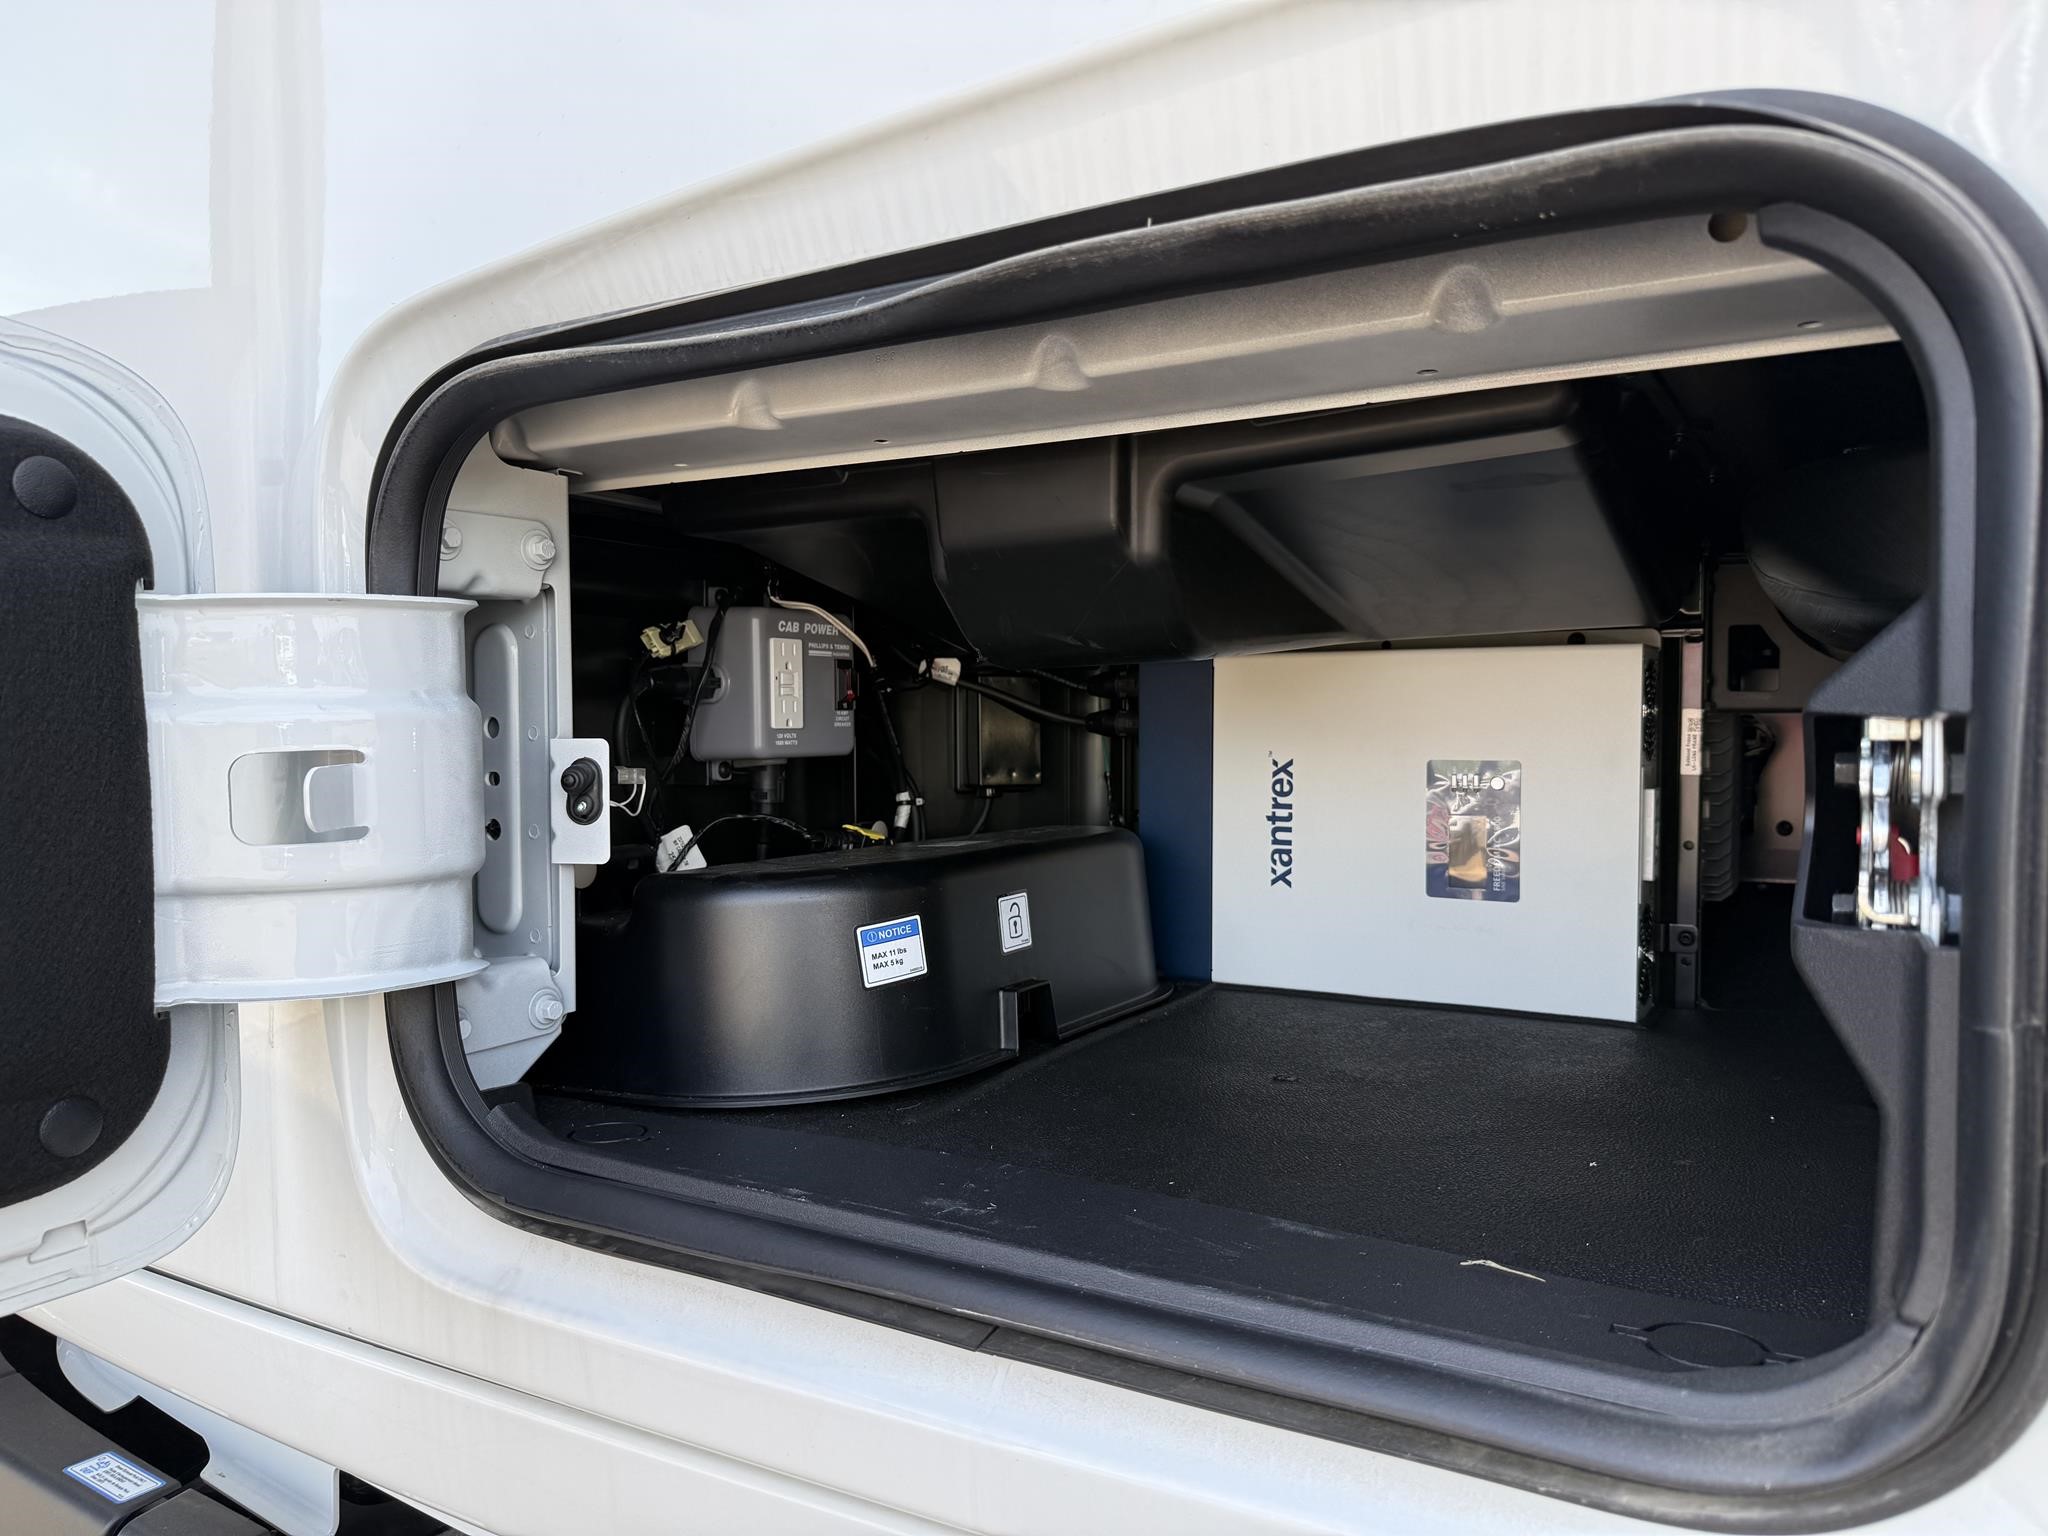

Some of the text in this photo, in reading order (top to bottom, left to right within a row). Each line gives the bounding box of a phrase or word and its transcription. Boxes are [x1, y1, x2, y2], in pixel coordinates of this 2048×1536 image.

[778, 620, 800, 633] CAB
[1265, 758, 1293, 888] xantrex
[1493, 851, 1501, 892] FREED
[878, 924, 912, 940] NOTICE
[871, 951, 888, 960] MAX
[897, 947, 907, 955] lbs
[873, 960, 889, 970] MAX
[895, 958, 904, 966] kg
